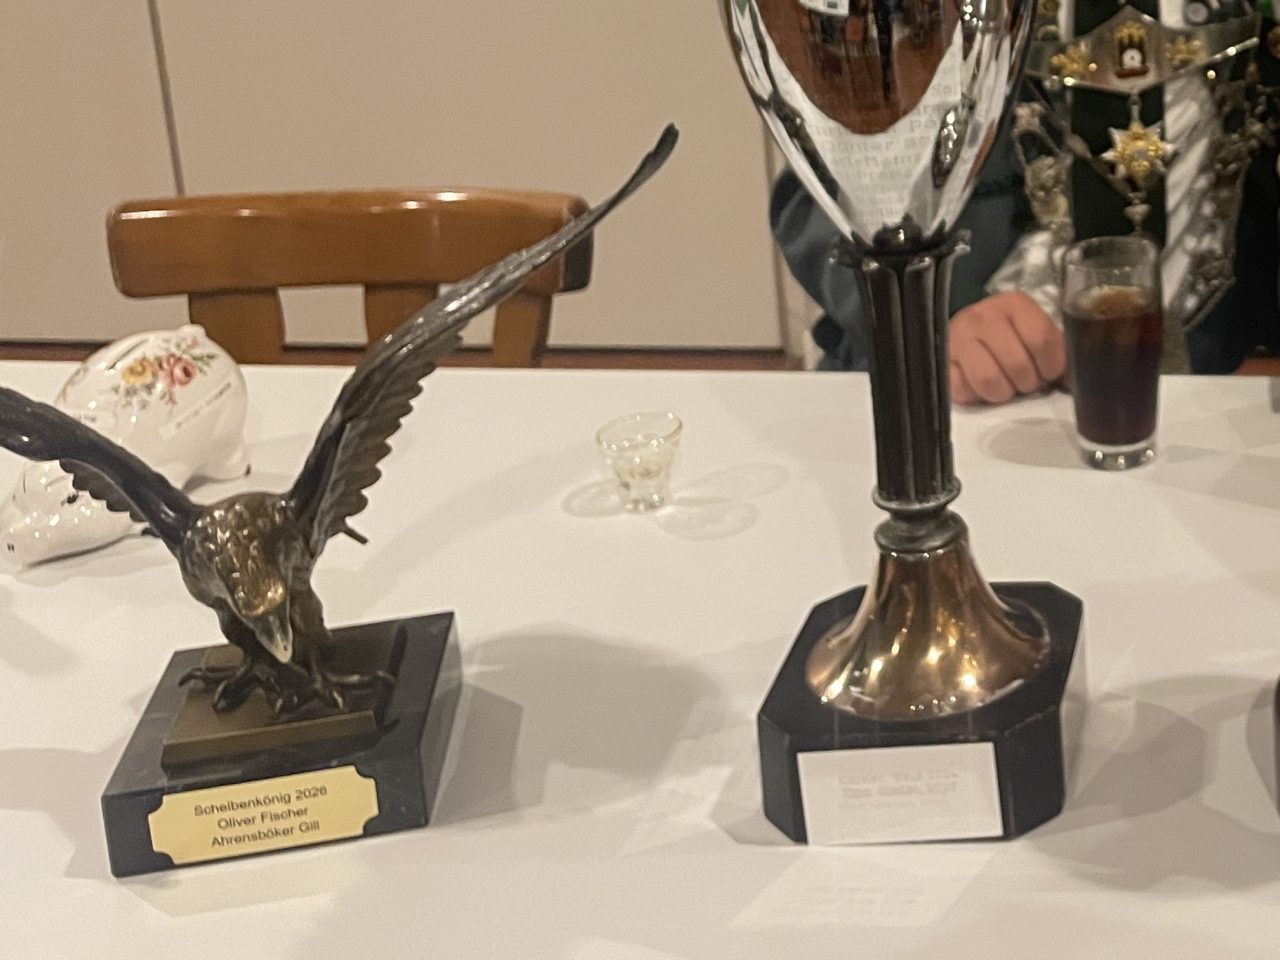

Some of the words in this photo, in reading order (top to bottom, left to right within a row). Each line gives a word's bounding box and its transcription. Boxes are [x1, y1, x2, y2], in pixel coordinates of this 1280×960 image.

[194, 792, 291, 817] Scheibenkönig
[217, 815, 257, 830] Oliver
[260, 806, 309, 824] Fischer
[211, 825, 295, 847] Ahrensböker
